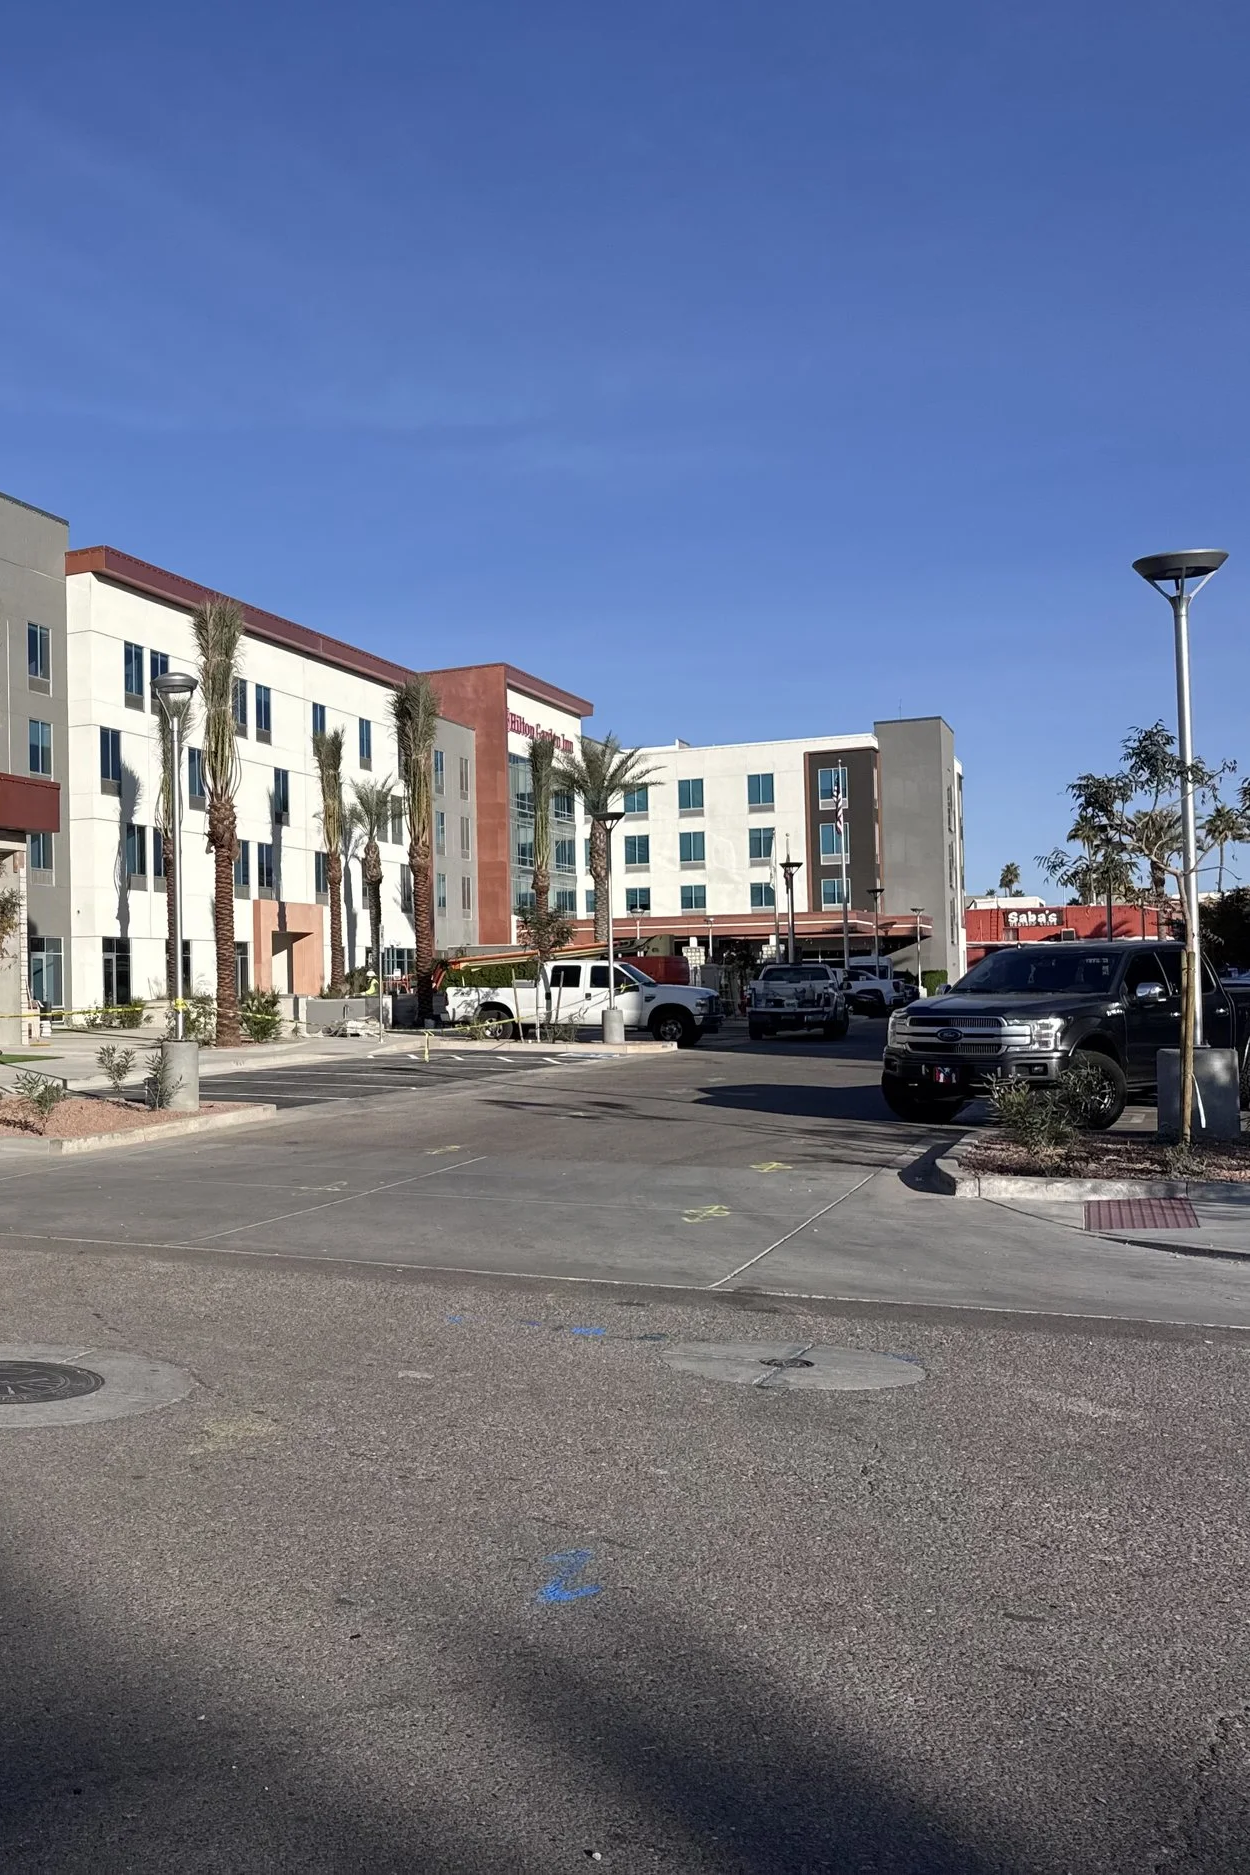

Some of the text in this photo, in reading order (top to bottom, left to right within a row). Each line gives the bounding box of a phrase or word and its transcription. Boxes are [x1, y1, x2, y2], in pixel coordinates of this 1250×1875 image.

[510, 712, 535, 740] Hilton
[561, 733, 574, 754] Inn
[1008, 910, 1058, 923] Saba's
